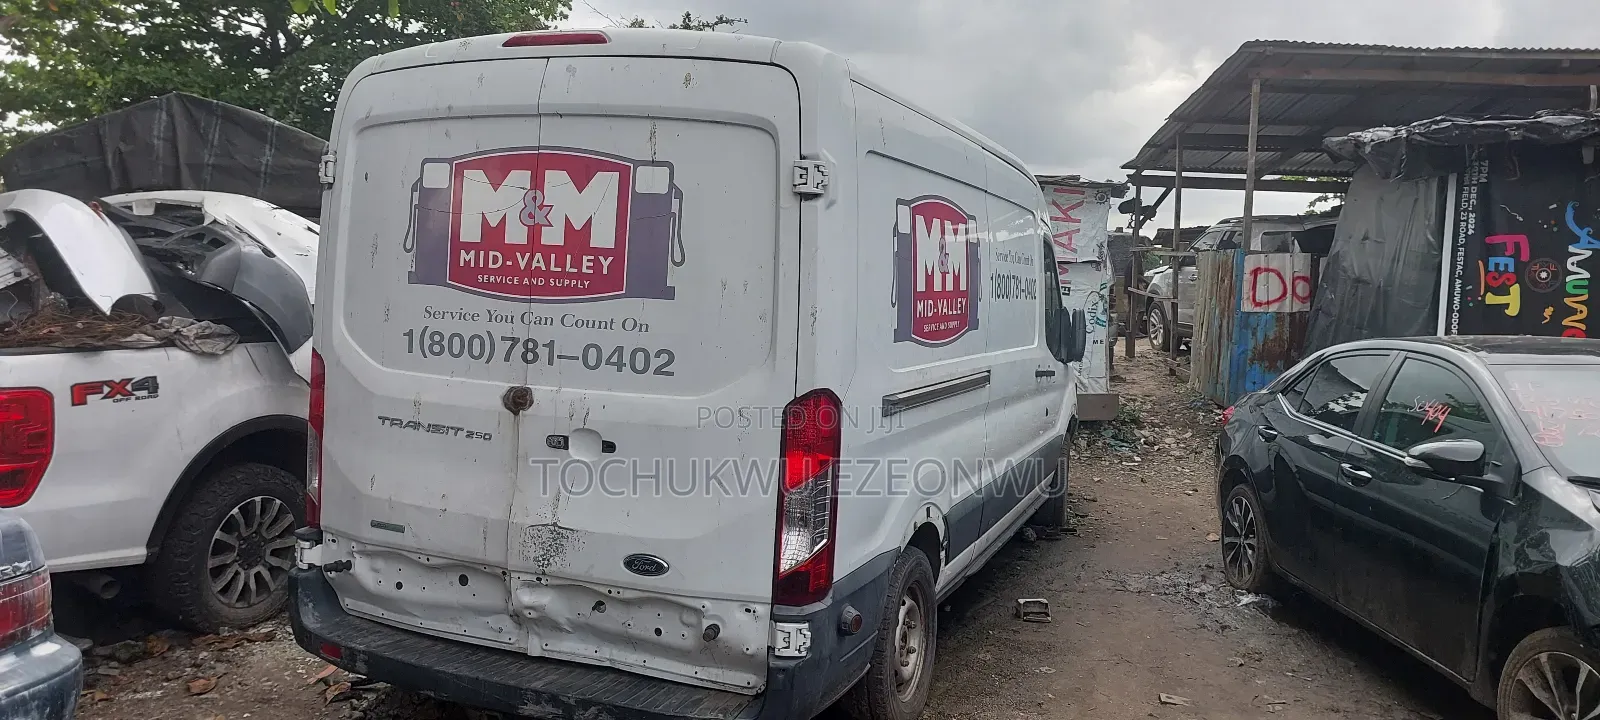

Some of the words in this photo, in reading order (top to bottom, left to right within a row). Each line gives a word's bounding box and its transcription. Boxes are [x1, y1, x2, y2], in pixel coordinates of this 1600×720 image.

[459, 169, 620, 249] M&M
[1460, 186, 1470, 211] FIELD,
[1460, 211, 1468, 221] 23
[1467, 212, 1476, 235] 2024
[1456, 221, 1467, 246] ROAD,
[459, 250, 615, 275] MID-VALLEY
[915, 214, 967, 292] M&M
[1454, 247, 1465, 278] FESTAC,
[478, 274, 520, 285] SERVICE
[523, 277, 545, 286] AND
[549, 278, 590, 289] SUPPLY
[1485, 234, 1530, 316] FEST
[423, 305, 480, 322] Service
[486, 309, 515, 325] You
[521, 311, 554, 327] Can
[560, 313, 615, 331] Count
[621, 317, 650, 333] On
[916, 297, 967, 318] MID-VALLEY
[1086, 301, 1099, 334] Codix
[923, 322, 940, 333] SERVICE
[939, 322, 948, 331] AND
[948, 320, 960, 330] SUPPLY
[70, 376, 159, 407] FX4
[378, 416, 464, 436] TRANSIT
[465, 430, 492, 441] 250
